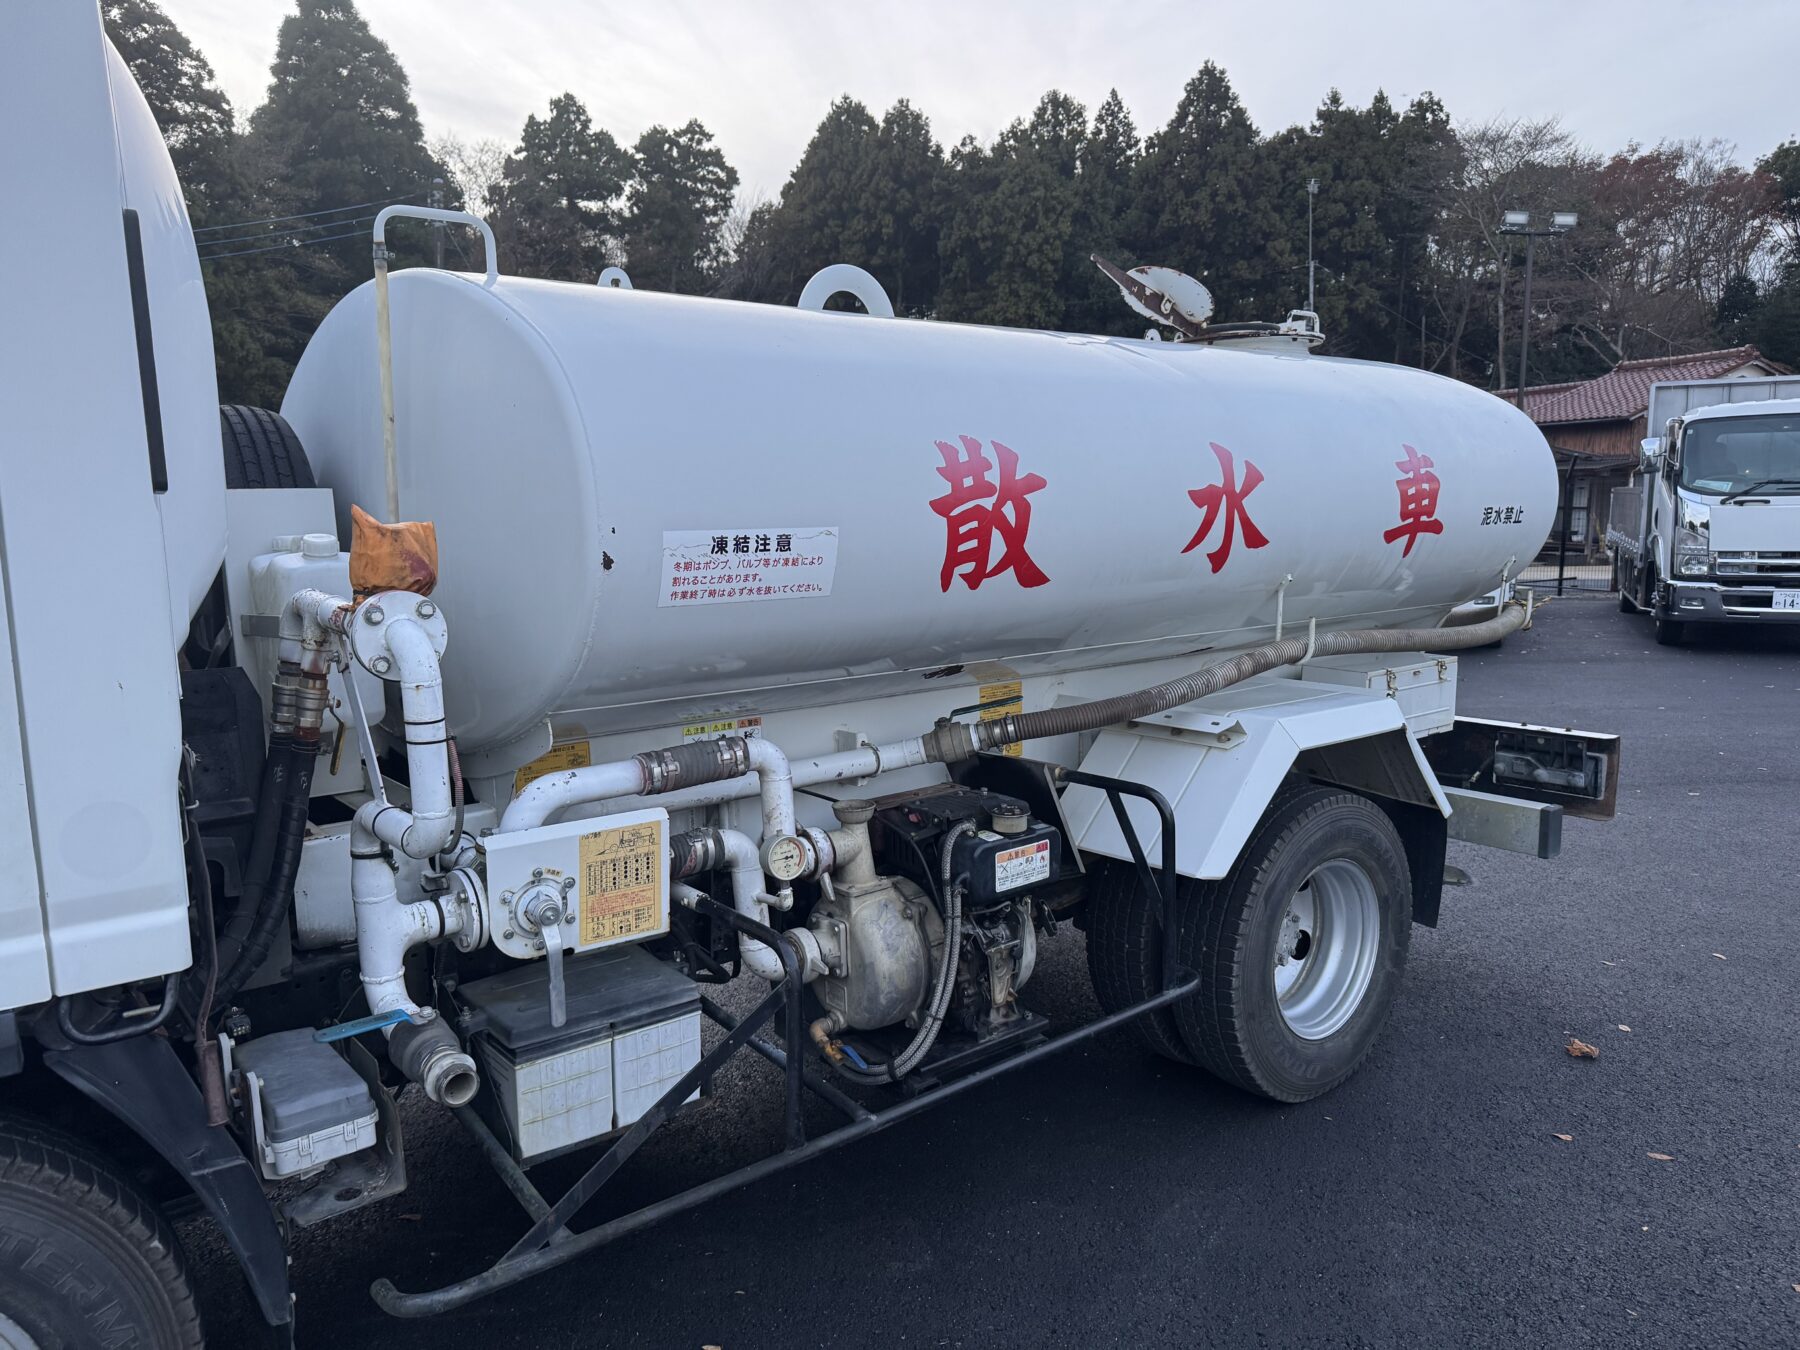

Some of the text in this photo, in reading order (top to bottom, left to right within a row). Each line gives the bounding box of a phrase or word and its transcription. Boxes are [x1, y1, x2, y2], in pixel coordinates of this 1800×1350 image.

[1481, 505, 1524, 526] 泥水禁止
[711, 534, 793, 555] 凍結注意
[672, 573, 762, 587] 割れることがあります。
[670, 583, 823, 601] 作業終了時は必ず水を抜いてください。
